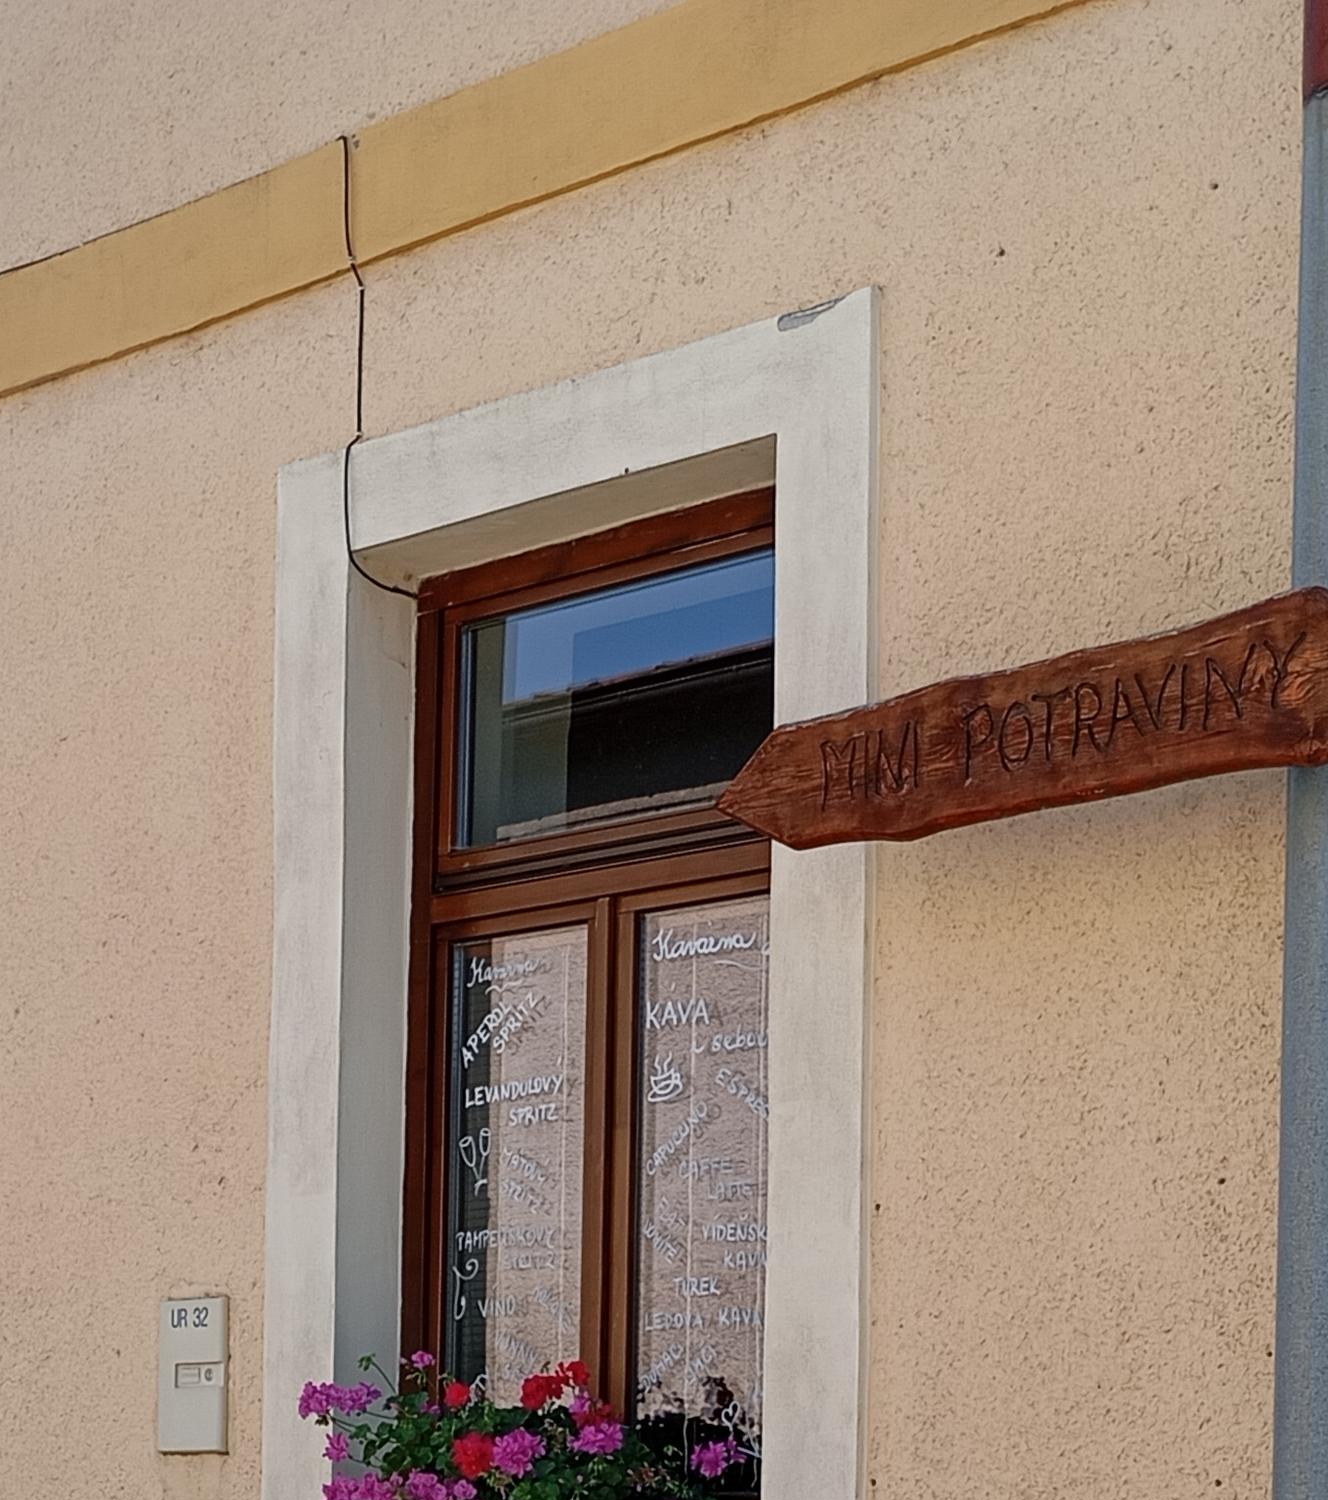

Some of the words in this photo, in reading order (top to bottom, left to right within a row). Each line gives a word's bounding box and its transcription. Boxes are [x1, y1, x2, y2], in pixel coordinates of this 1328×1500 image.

[963, 631, 1307, 788] POTRAVINY
[461, 1000, 512, 1069] APEROL
[171, 1308, 188, 1329] UR
[192, 1306, 209, 1328] 32
